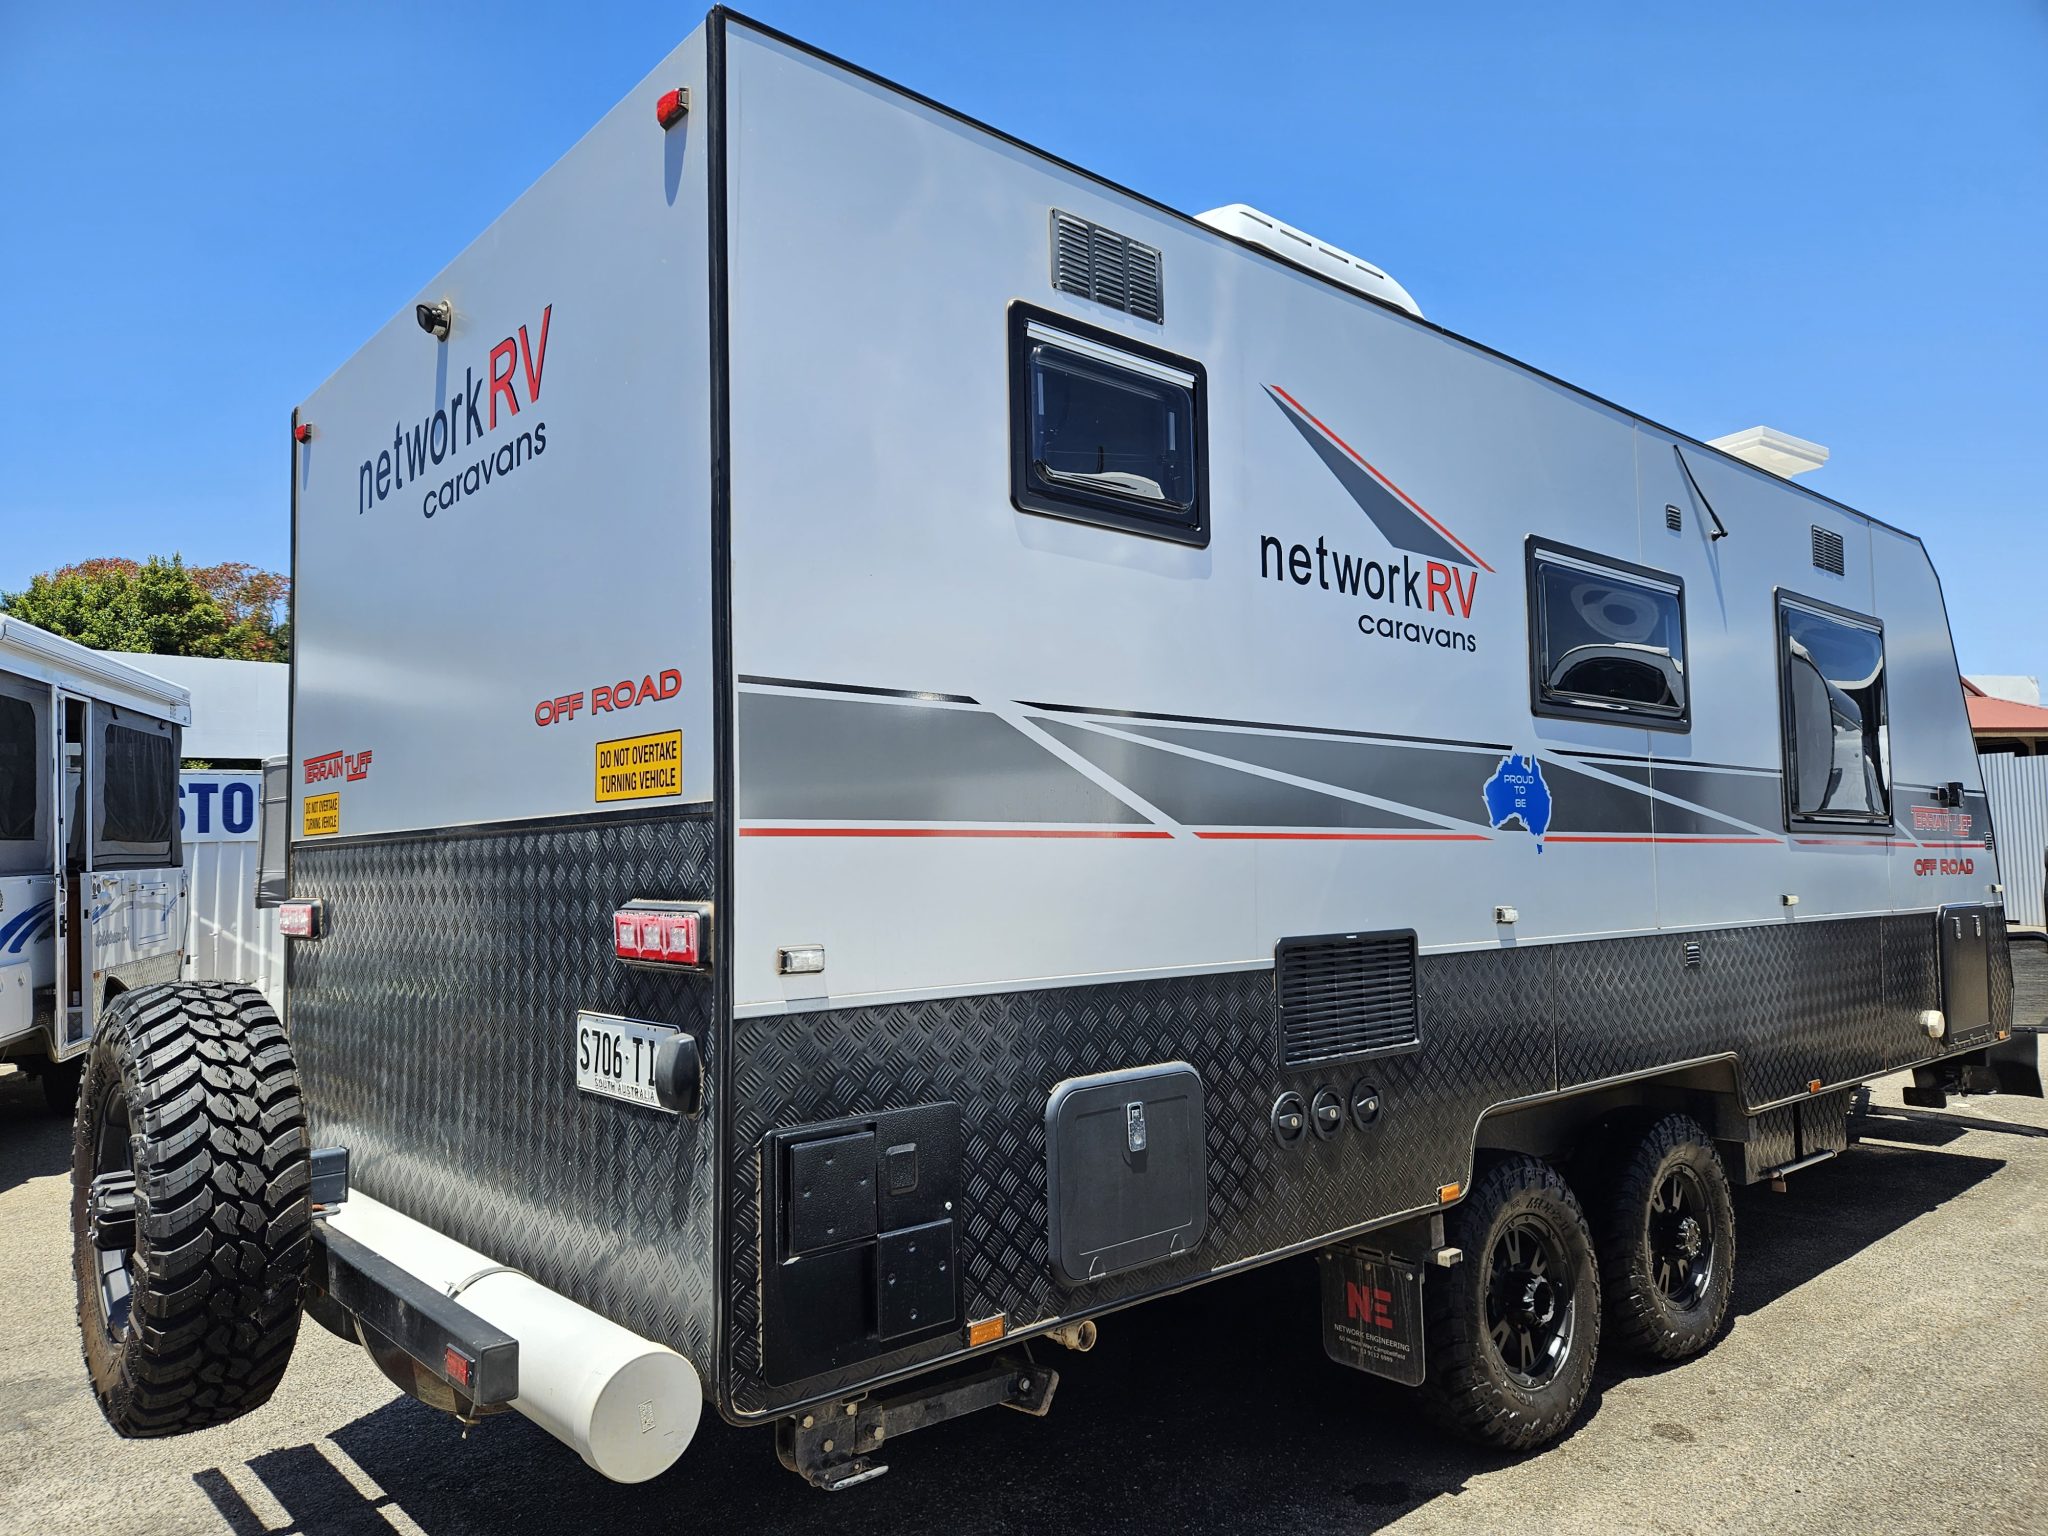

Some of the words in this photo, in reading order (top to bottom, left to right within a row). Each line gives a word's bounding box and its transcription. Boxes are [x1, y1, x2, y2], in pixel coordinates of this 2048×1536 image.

[423, 422, 546, 519] caravans
[1358, 614, 1476, 652] caravans
[535, 691, 584, 727] OFF
[592, 668, 683, 715] ROAD
[303, 750, 343, 784] TERRAIN
[344, 750, 373, 782] TUFF
[600, 750, 611, 769] DO
[613, 748, 630, 767] NOT
[632, 740, 677, 765] OVERTAKE
[601, 772, 636, 794] TURNING
[639, 767, 676, 789] VEHICLE
[1503, 774, 1534, 784] PROUD
[1514, 785, 1526, 795] TO
[319, 798, 337, 813] OVERTAKE
[1515, 798, 1527, 808] BE
[1914, 858, 1937, 876] OFF
[1940, 858, 1974, 875] ROAD
[594, 1078, 616, 1091] SOUTH
[618, 1084, 655, 1101] AUSTRALIA
[1347, 1281, 1393, 1329] NE
[1334, 1323, 1364, 1338] NETWORK
[1366, 1332, 1410, 1352] ENGINEERING
